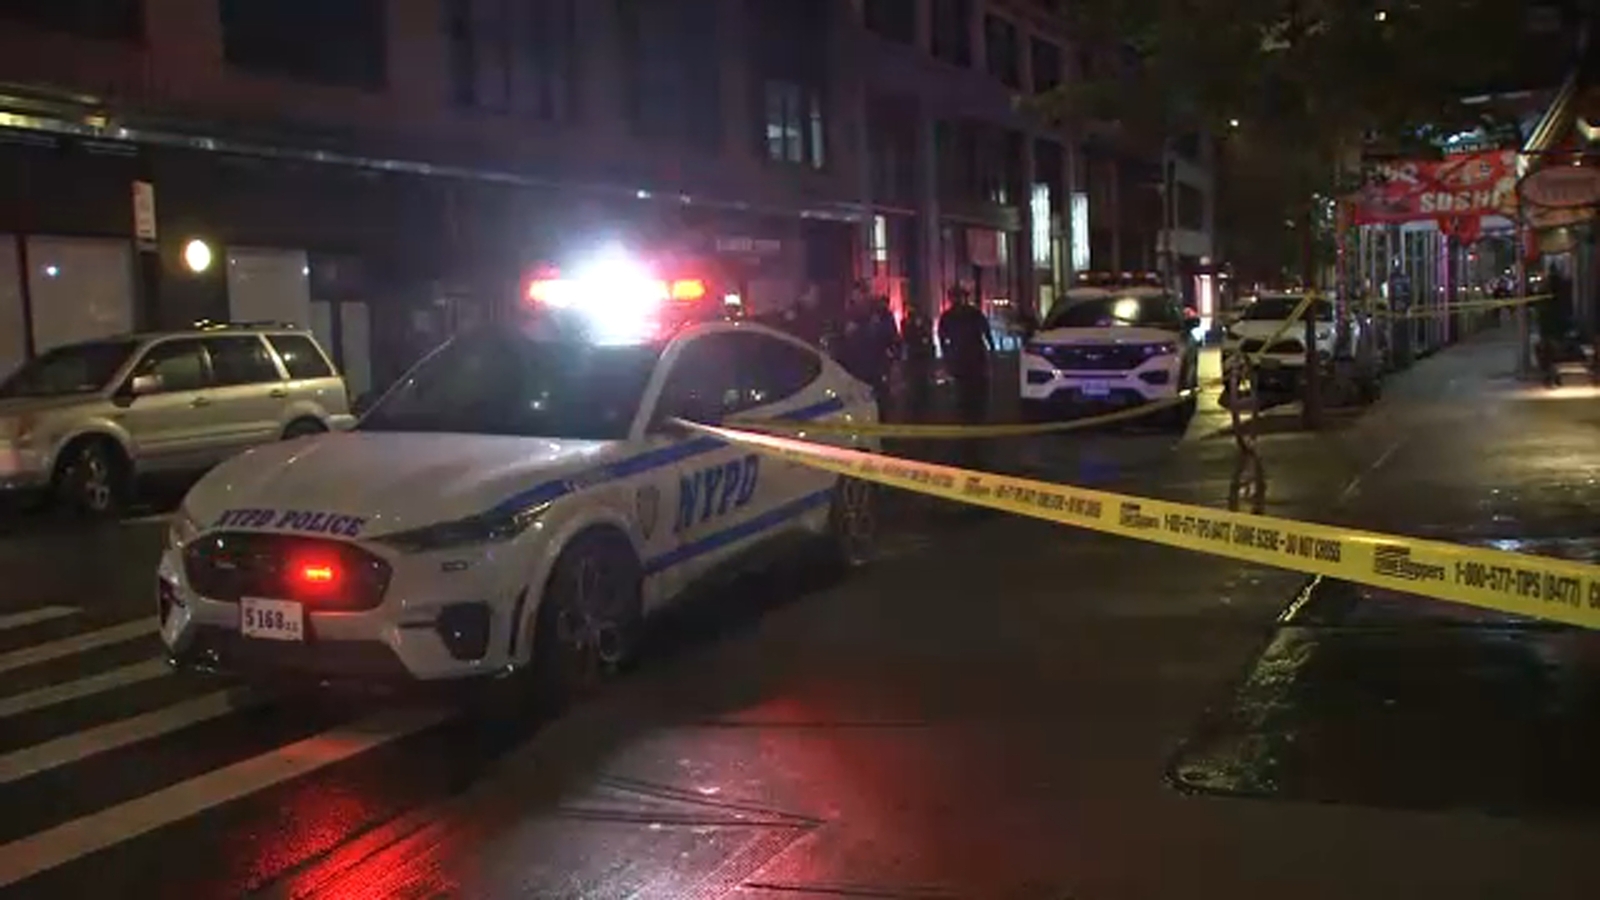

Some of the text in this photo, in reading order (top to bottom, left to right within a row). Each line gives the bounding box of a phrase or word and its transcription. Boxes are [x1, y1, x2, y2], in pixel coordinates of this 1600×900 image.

[1419, 190, 1501, 213] SUSHI
[673, 454, 760, 534] NYPD
[212, 509, 367, 538] NYPD POLICE
[1454, 561, 1541, 598] 1-800-577-TIPS
[1544, 571, 1580, 608] (8477)
